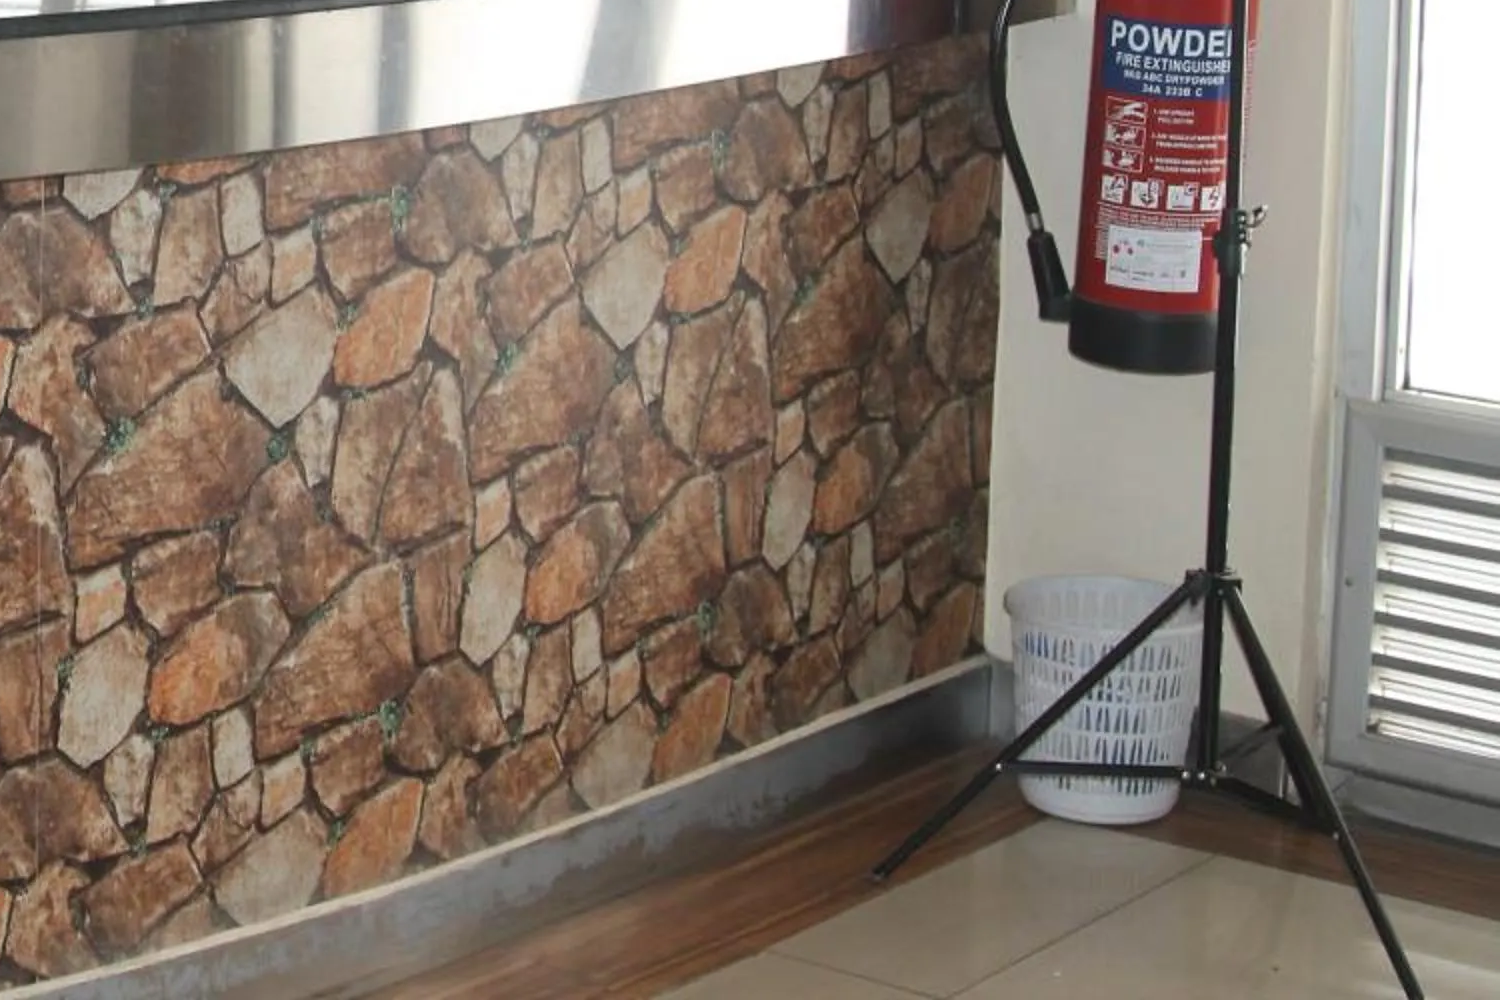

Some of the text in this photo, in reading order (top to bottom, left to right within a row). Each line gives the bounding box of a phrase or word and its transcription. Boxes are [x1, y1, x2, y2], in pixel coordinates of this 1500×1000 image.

[1111, 20, 1233, 59] POWDE
[1115, 51, 1141, 69] FIRE
[1195, 87, 1203, 97] C
